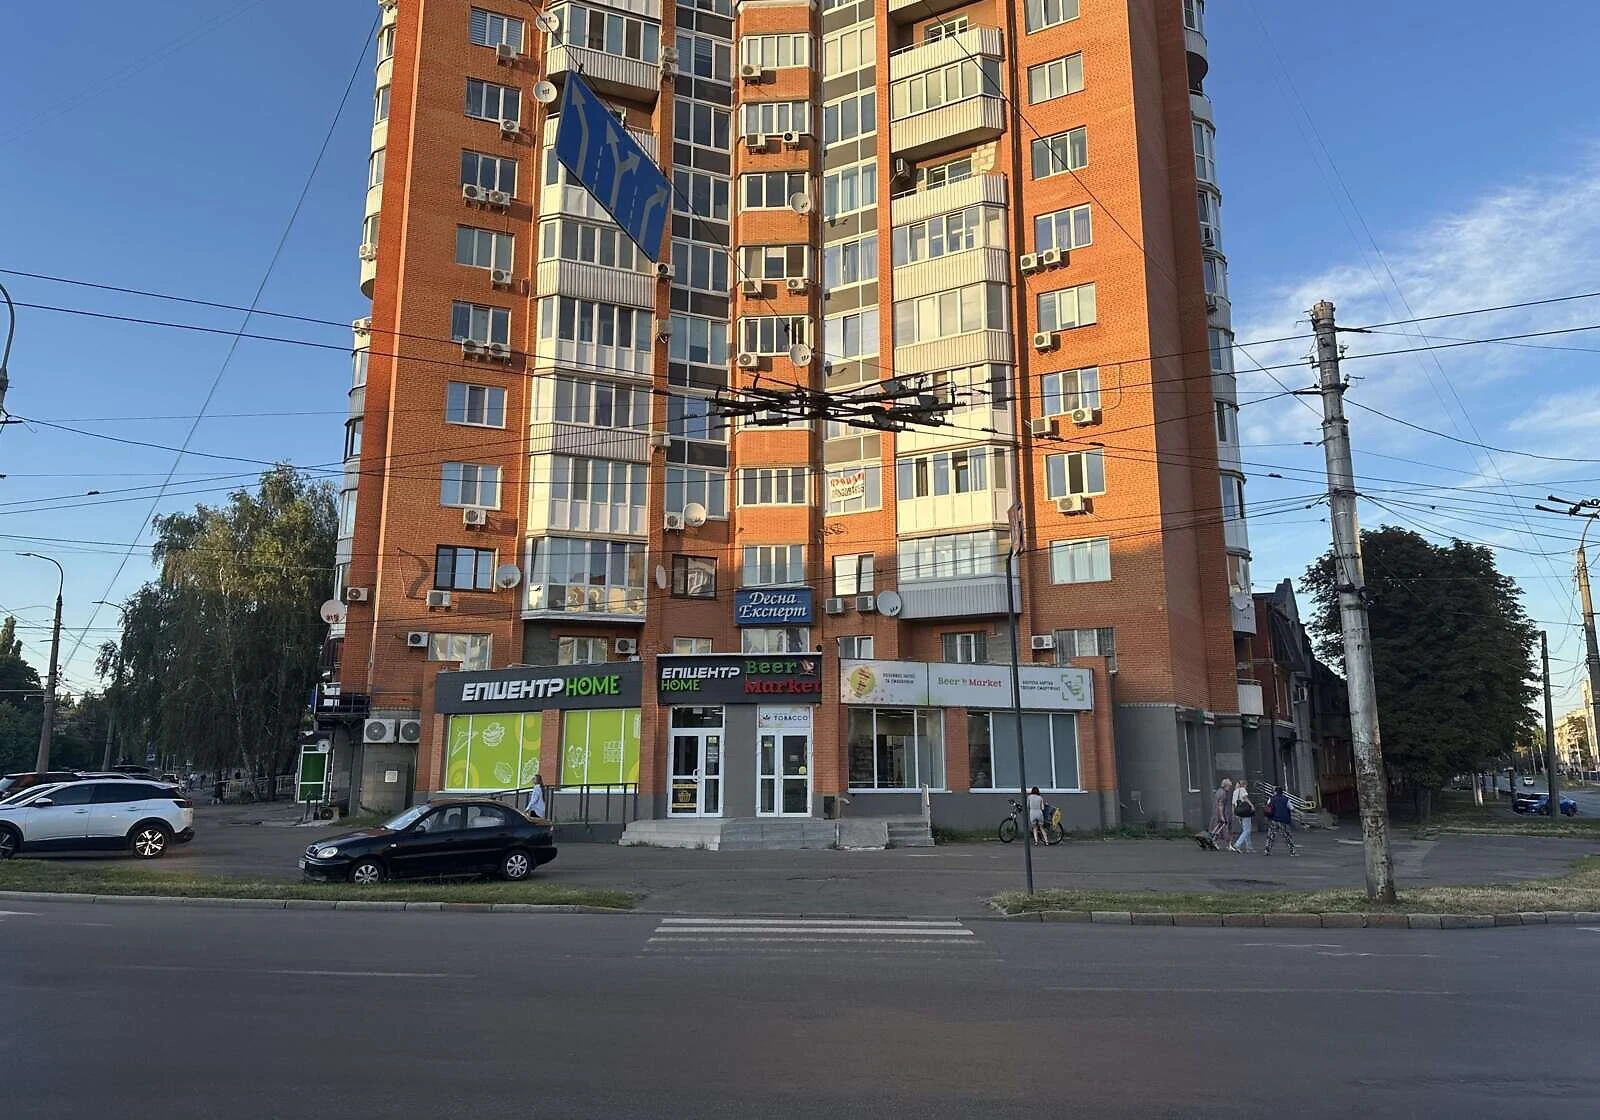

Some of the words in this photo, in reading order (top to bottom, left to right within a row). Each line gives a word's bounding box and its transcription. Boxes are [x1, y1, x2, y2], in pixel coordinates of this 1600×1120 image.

[749, 592, 797, 605] Десна
[739, 605, 807, 621] Експерт
[662, 667, 740, 679] ЕПІЦЕНТР
[745, 661, 797, 674] Beer
[462, 678, 564, 701] ЕПІЦЕНТР
[565, 675, 620, 696] HOME
[661, 680, 700, 691] HOME
[744, 680, 822, 695] Market
[937, 677, 960, 686] Beer
[969, 678, 1002, 688] Market
